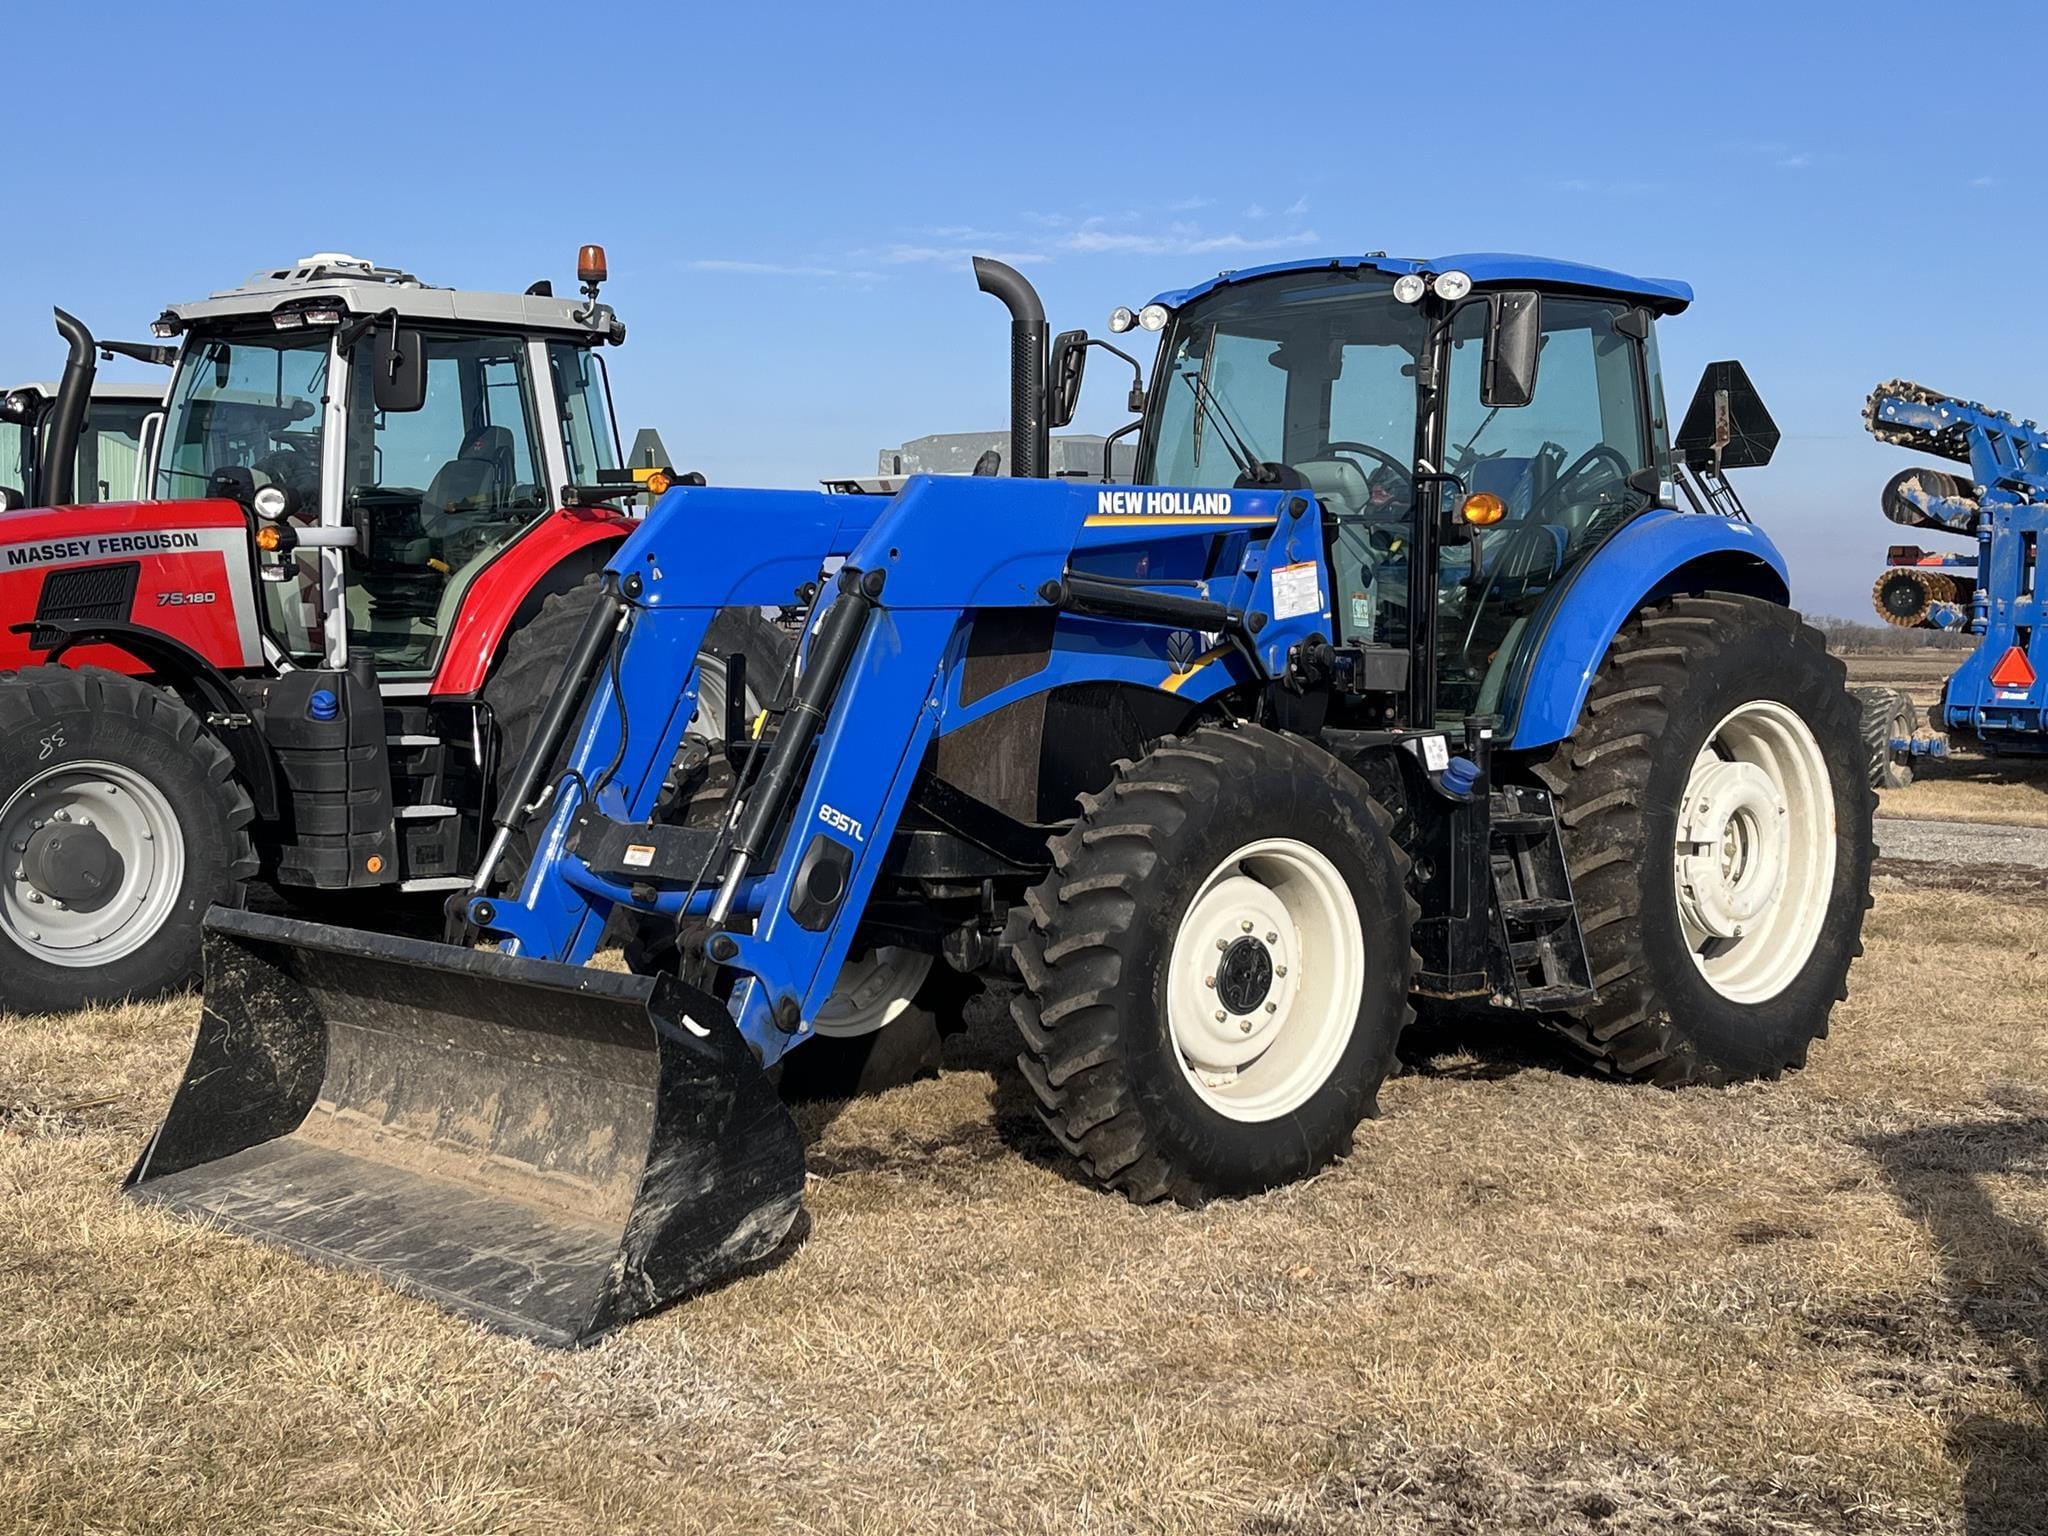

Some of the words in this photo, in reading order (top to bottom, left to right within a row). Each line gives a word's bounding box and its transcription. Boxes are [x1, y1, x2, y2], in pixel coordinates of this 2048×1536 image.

[1098, 491, 1143, 514] NEW
[1147, 492, 1231, 515] HOLLAND
[7, 540, 91, 565] MASSEY
[97, 533, 199, 553] FERGUSON
[157, 592, 216, 606] 7S.180
[818, 804, 864, 842] 835TL
